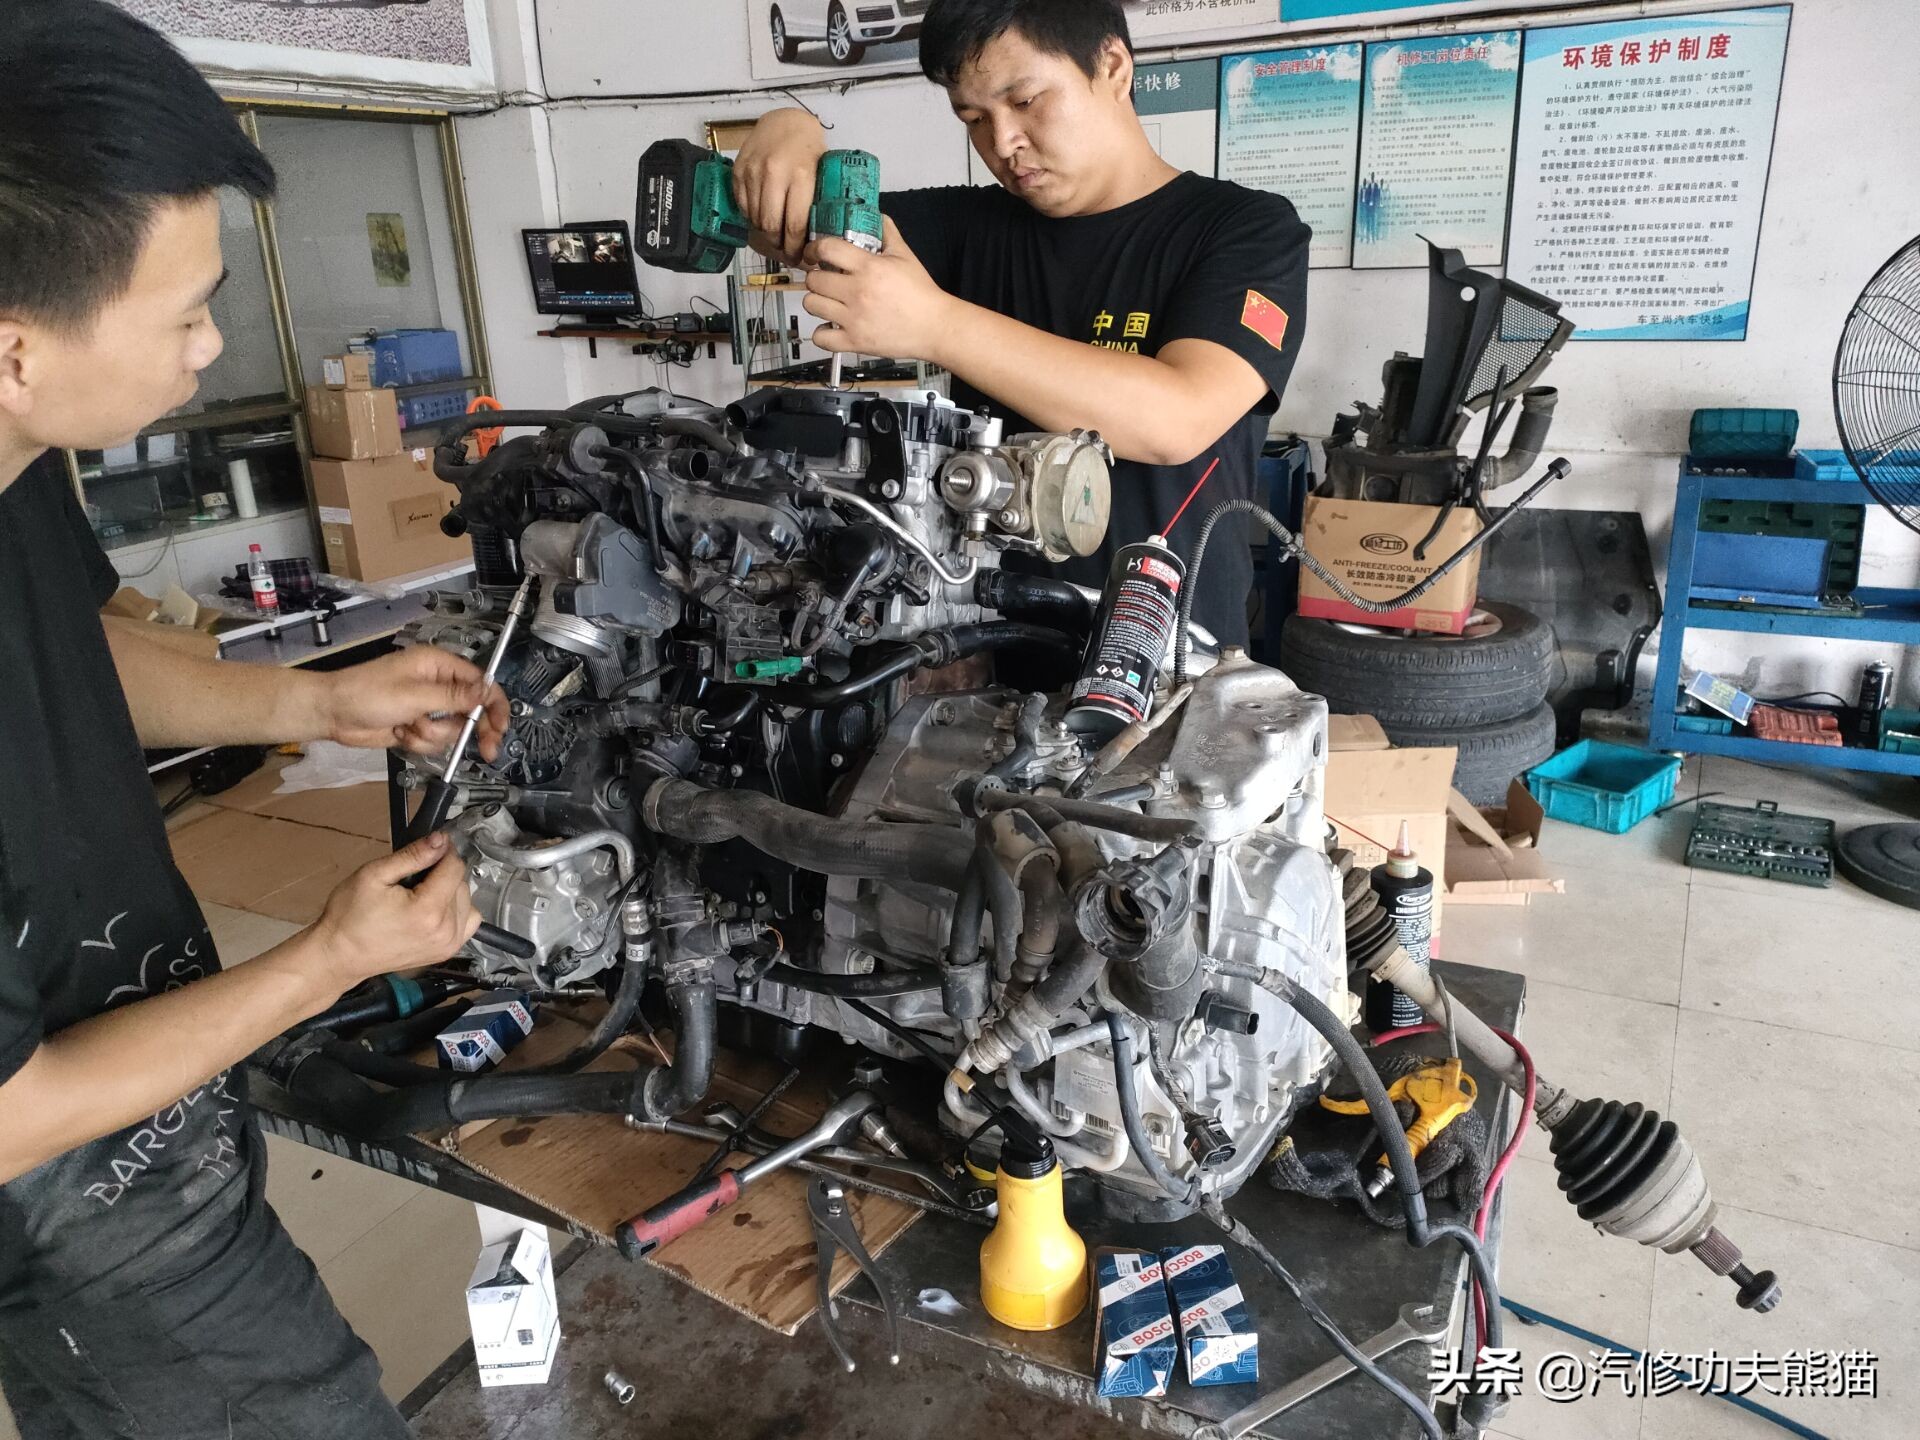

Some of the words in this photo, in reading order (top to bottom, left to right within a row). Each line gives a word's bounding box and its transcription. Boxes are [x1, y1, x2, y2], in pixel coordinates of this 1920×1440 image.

[1397, 47, 1489, 66] 机修工岗位责任
[1562, 34, 1732, 70] 环境保护制度
[1254, 58, 1327, 77] 安全管理制度
[1093, 309, 1150, 339] 中国
[1637, 314, 1723, 324] 车至尚汽车快修
[1333, 559, 1433, 573] ANTI-FREEZE/COOLANT
[1346, 569, 1416, 584] 长效防冻冷却液
[509, 1003, 527, 1024] BOSCH
[461, 1031, 490, 1048] BOSCH
